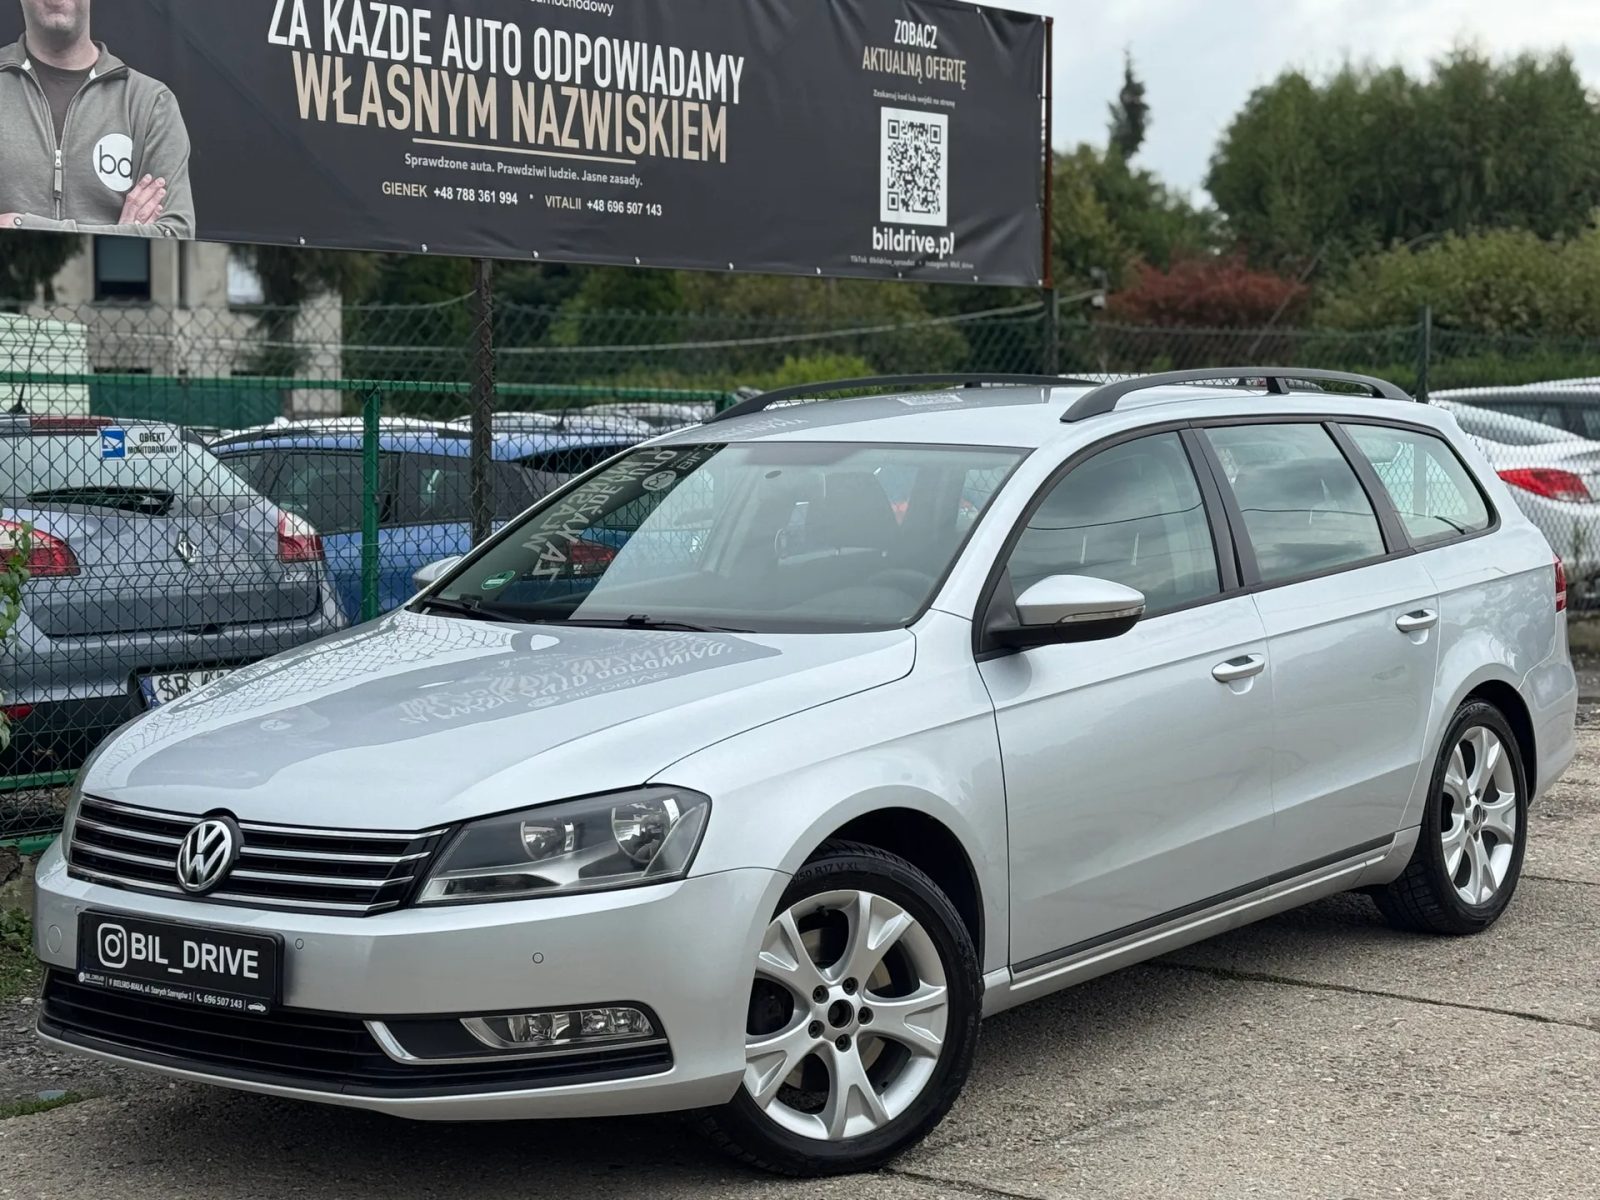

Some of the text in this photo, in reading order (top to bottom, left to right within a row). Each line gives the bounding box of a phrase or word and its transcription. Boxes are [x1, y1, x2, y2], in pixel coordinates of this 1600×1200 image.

[894, 19, 938, 49] ZOBACZ
[268, 0, 312, 48] ZA
[441, 14, 522, 76] AUTO
[533, 27, 745, 105] ODPOWIADAMY
[862, 46, 966, 90] AKTUALNĄ OFERTĘ
[291, 50, 727, 164] WŁASNYM NAZWISKIEM
[404, 152, 643, 188] Sprawdzone auta. Prawdziwi ludzie. Jasne zasady.
[382, 181, 662, 216] GIENEK +48 788 361 994 VITALII +48 696 507 143
[872, 226, 955, 260] bildrive.pl
[131, 932, 259, 979] BIL_DRIVE
[204, 994, 216, 1005] 696
[216, 997, 229, 1007] 507
[230, 999, 243, 1009] 143
